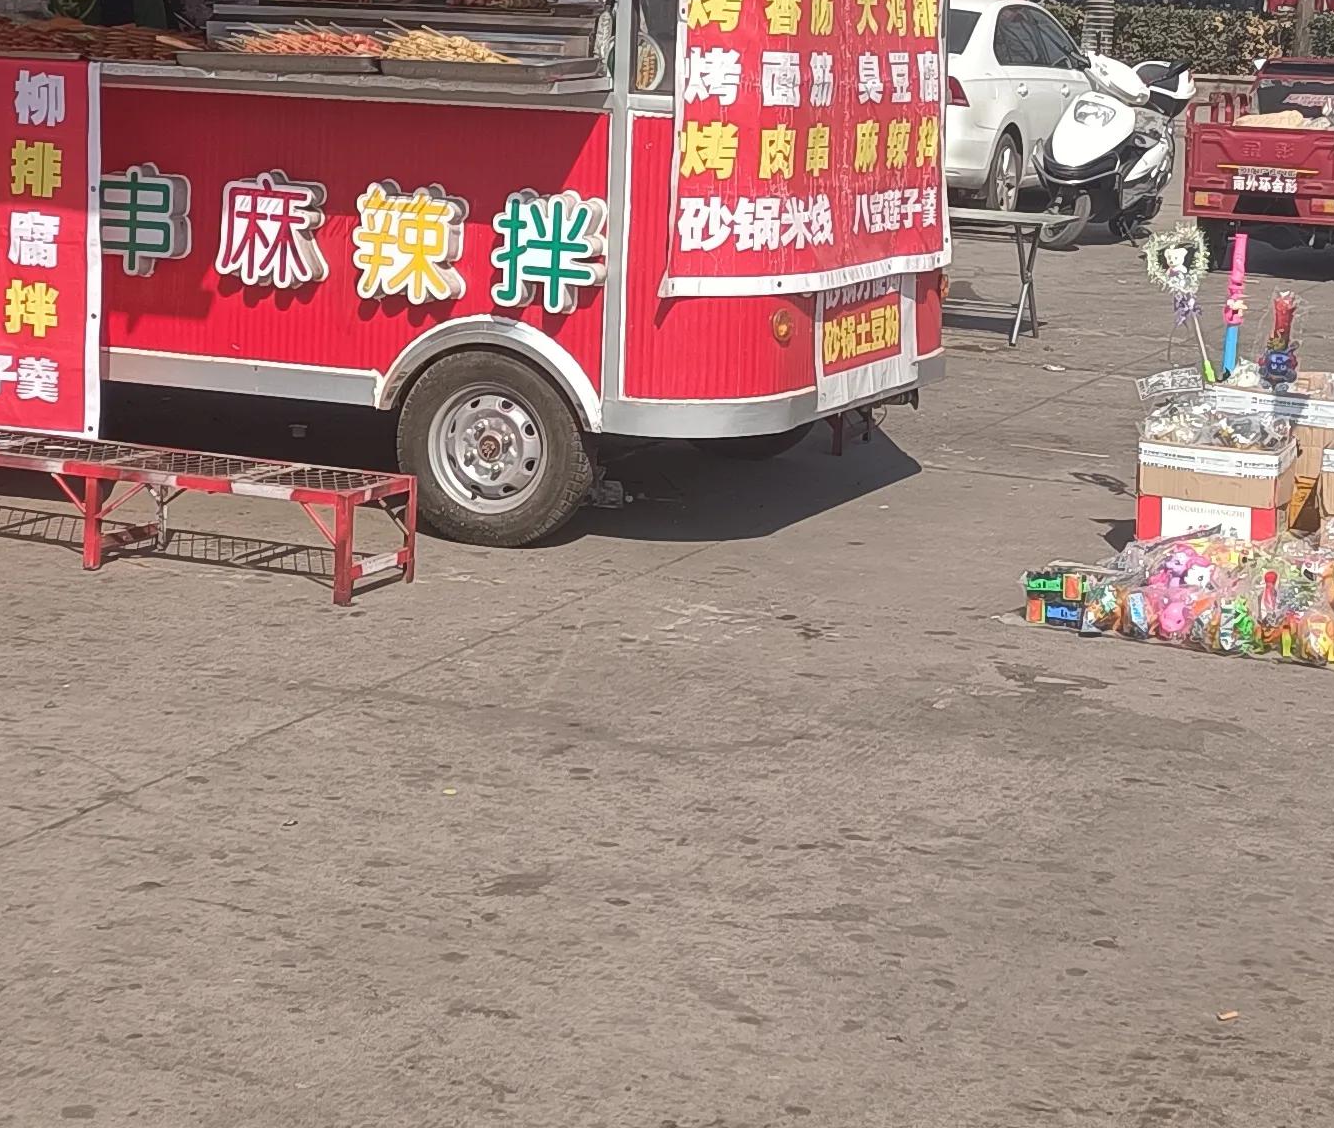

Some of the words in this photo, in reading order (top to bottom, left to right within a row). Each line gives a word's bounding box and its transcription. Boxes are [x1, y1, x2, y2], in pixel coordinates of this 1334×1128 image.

[683, 47, 833, 108] 烤面筋
[858, 51, 939, 104] 臭豆腐
[679, 120, 831, 180] 烤肉串
[854, 117, 938, 171] 麻辣拌
[678, 195, 834, 253] 砂锅米线
[824, 305, 900, 365] 砂锅土豆粉
